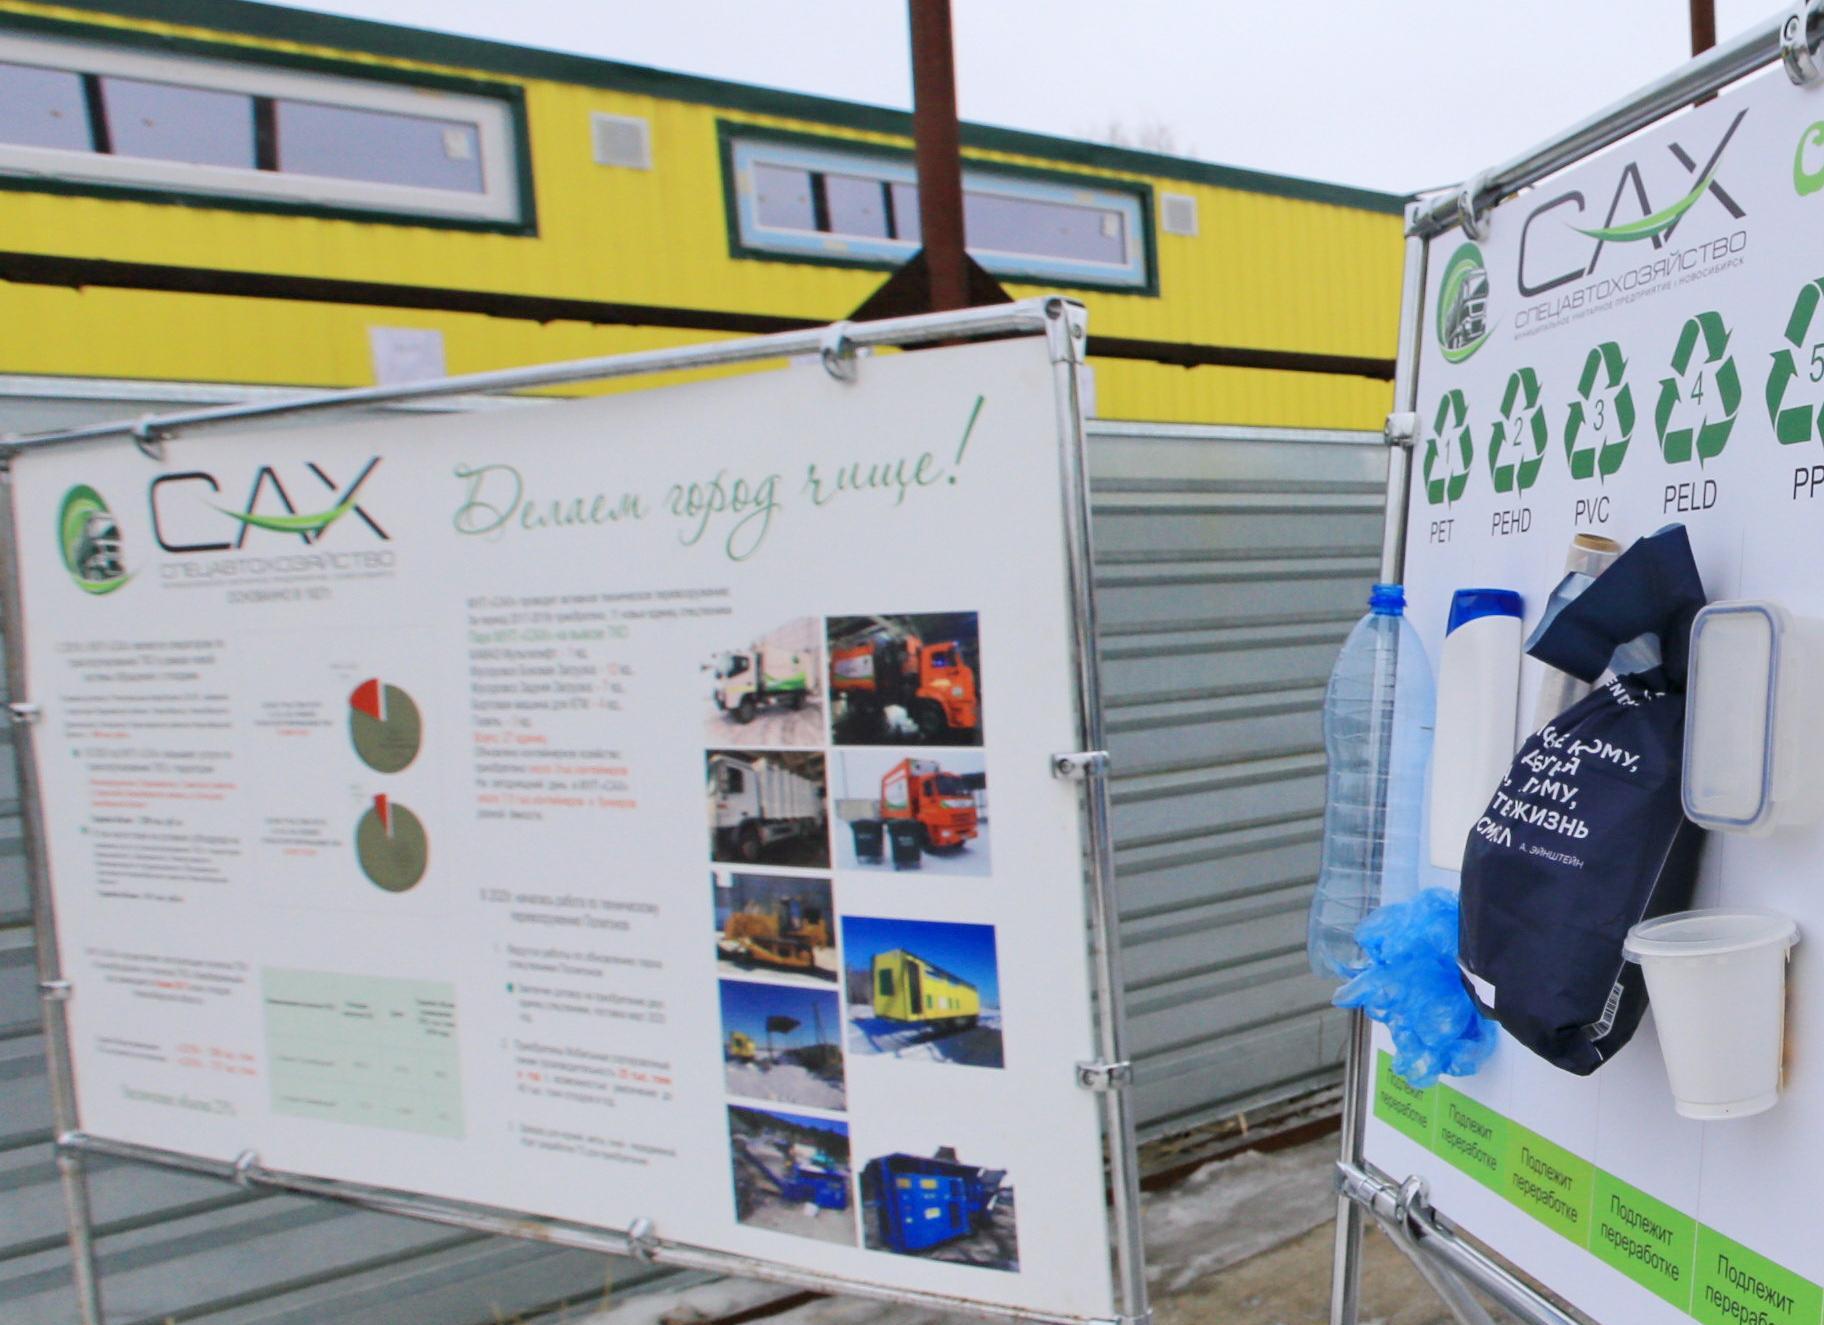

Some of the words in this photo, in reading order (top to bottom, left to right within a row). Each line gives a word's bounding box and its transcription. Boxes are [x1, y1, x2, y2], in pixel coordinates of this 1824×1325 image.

[1517, 107, 1749, 298] САХ
[1514, 230, 1747, 329] СПЕЦАВТОХОЗЯЙСТВО
[1680, 256, 1744, 285] НОВОСИБИРСК
[1691, 371, 1703, 405] 4
[1513, 416, 1523, 446] 2
[1593, 399, 1604, 431] 3
[453, 462, 648, 536] Делаем
[667, 469, 782, 562] город
[803, 395, 985, 506] чище!
[1663, 479, 1717, 514] PELD
[148, 455, 391, 553] САХ
[1492, 508, 1532, 536] PEHD
[1575, 496, 1610, 526] PVC
[1430, 519, 1454, 543] PET
[1529, 844, 1584, 870] ЭЙНШТЕЙН
[1380, 1091, 1428, 1130] переработке
[1448, 1104, 1493, 1140] Подлежит
[1441, 1127, 1497, 1172] переработке
[1521, 1146, 1573, 1191] Подлежит
[1512, 1172, 1578, 1224] переработке
[1610, 1194, 1674, 1246] Подлежит
[1600, 1222, 1680, 1282] переработке
[1716, 1253, 1796, 1316] Подлежит
